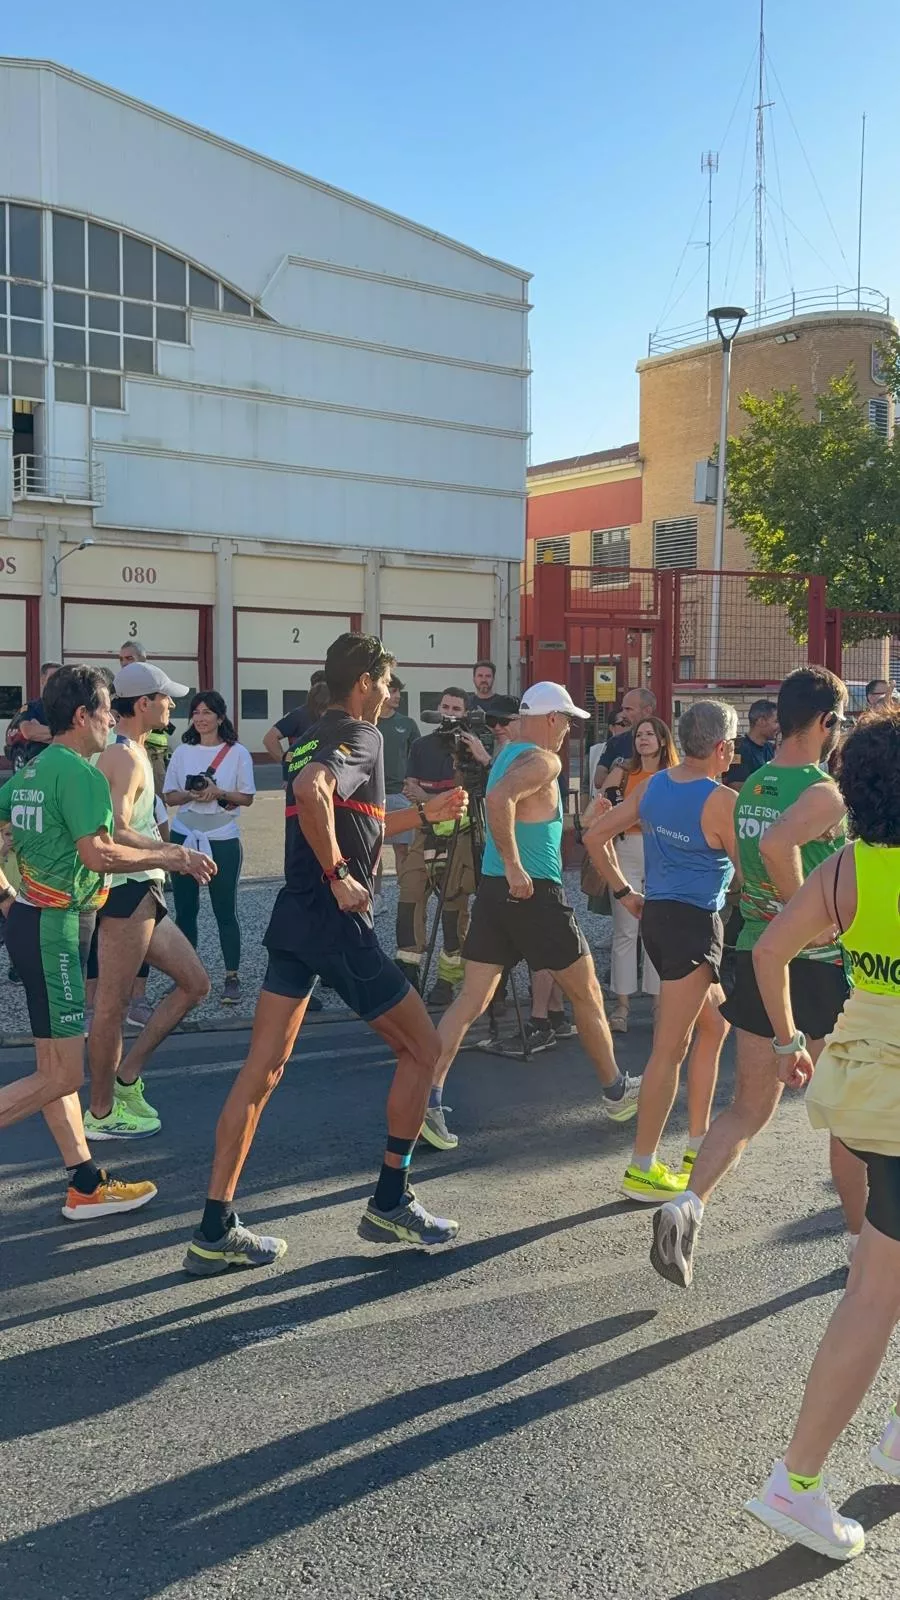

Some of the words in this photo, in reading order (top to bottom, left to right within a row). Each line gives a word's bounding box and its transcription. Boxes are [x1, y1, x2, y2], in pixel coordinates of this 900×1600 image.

[121, 566, 157, 584] 080
[128, 620, 138, 637] 3
[292, 628, 300, 643] 2
[428, 634, 435, 648] 1
[656, 825, 690, 843] dawako
[59, 952, 73, 1001] Huesca
